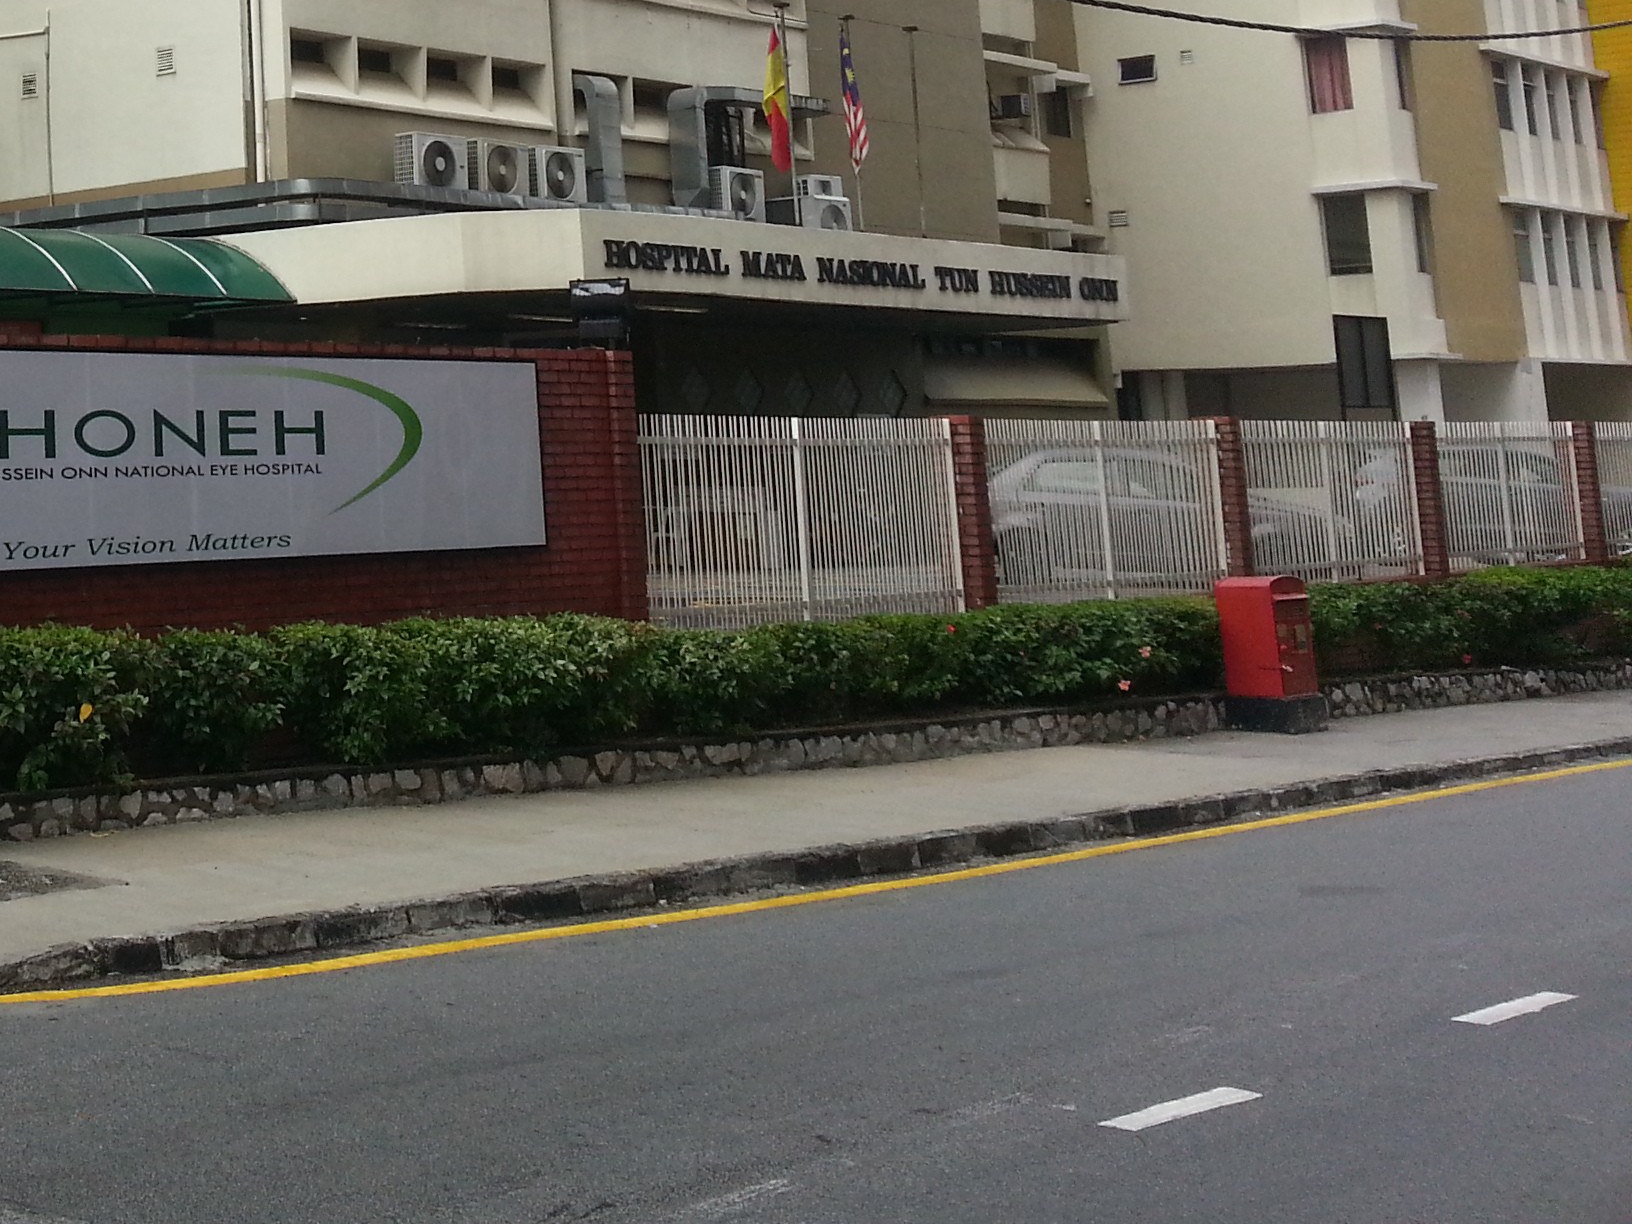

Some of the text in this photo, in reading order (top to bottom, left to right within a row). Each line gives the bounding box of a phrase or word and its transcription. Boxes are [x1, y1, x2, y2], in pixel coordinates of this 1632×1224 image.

[603, 239, 1118, 302] HOSPITAL MATA NASIONAL TUN HUSSEIN ONN
[61, 465, 109, 480] ONN
[115, 463, 205, 478] NATIONAL
[210, 463, 239, 477] EYE
[243, 462, 323, 476] HOSPITAL
[2, 532, 292, 561] Your Vision Matters
